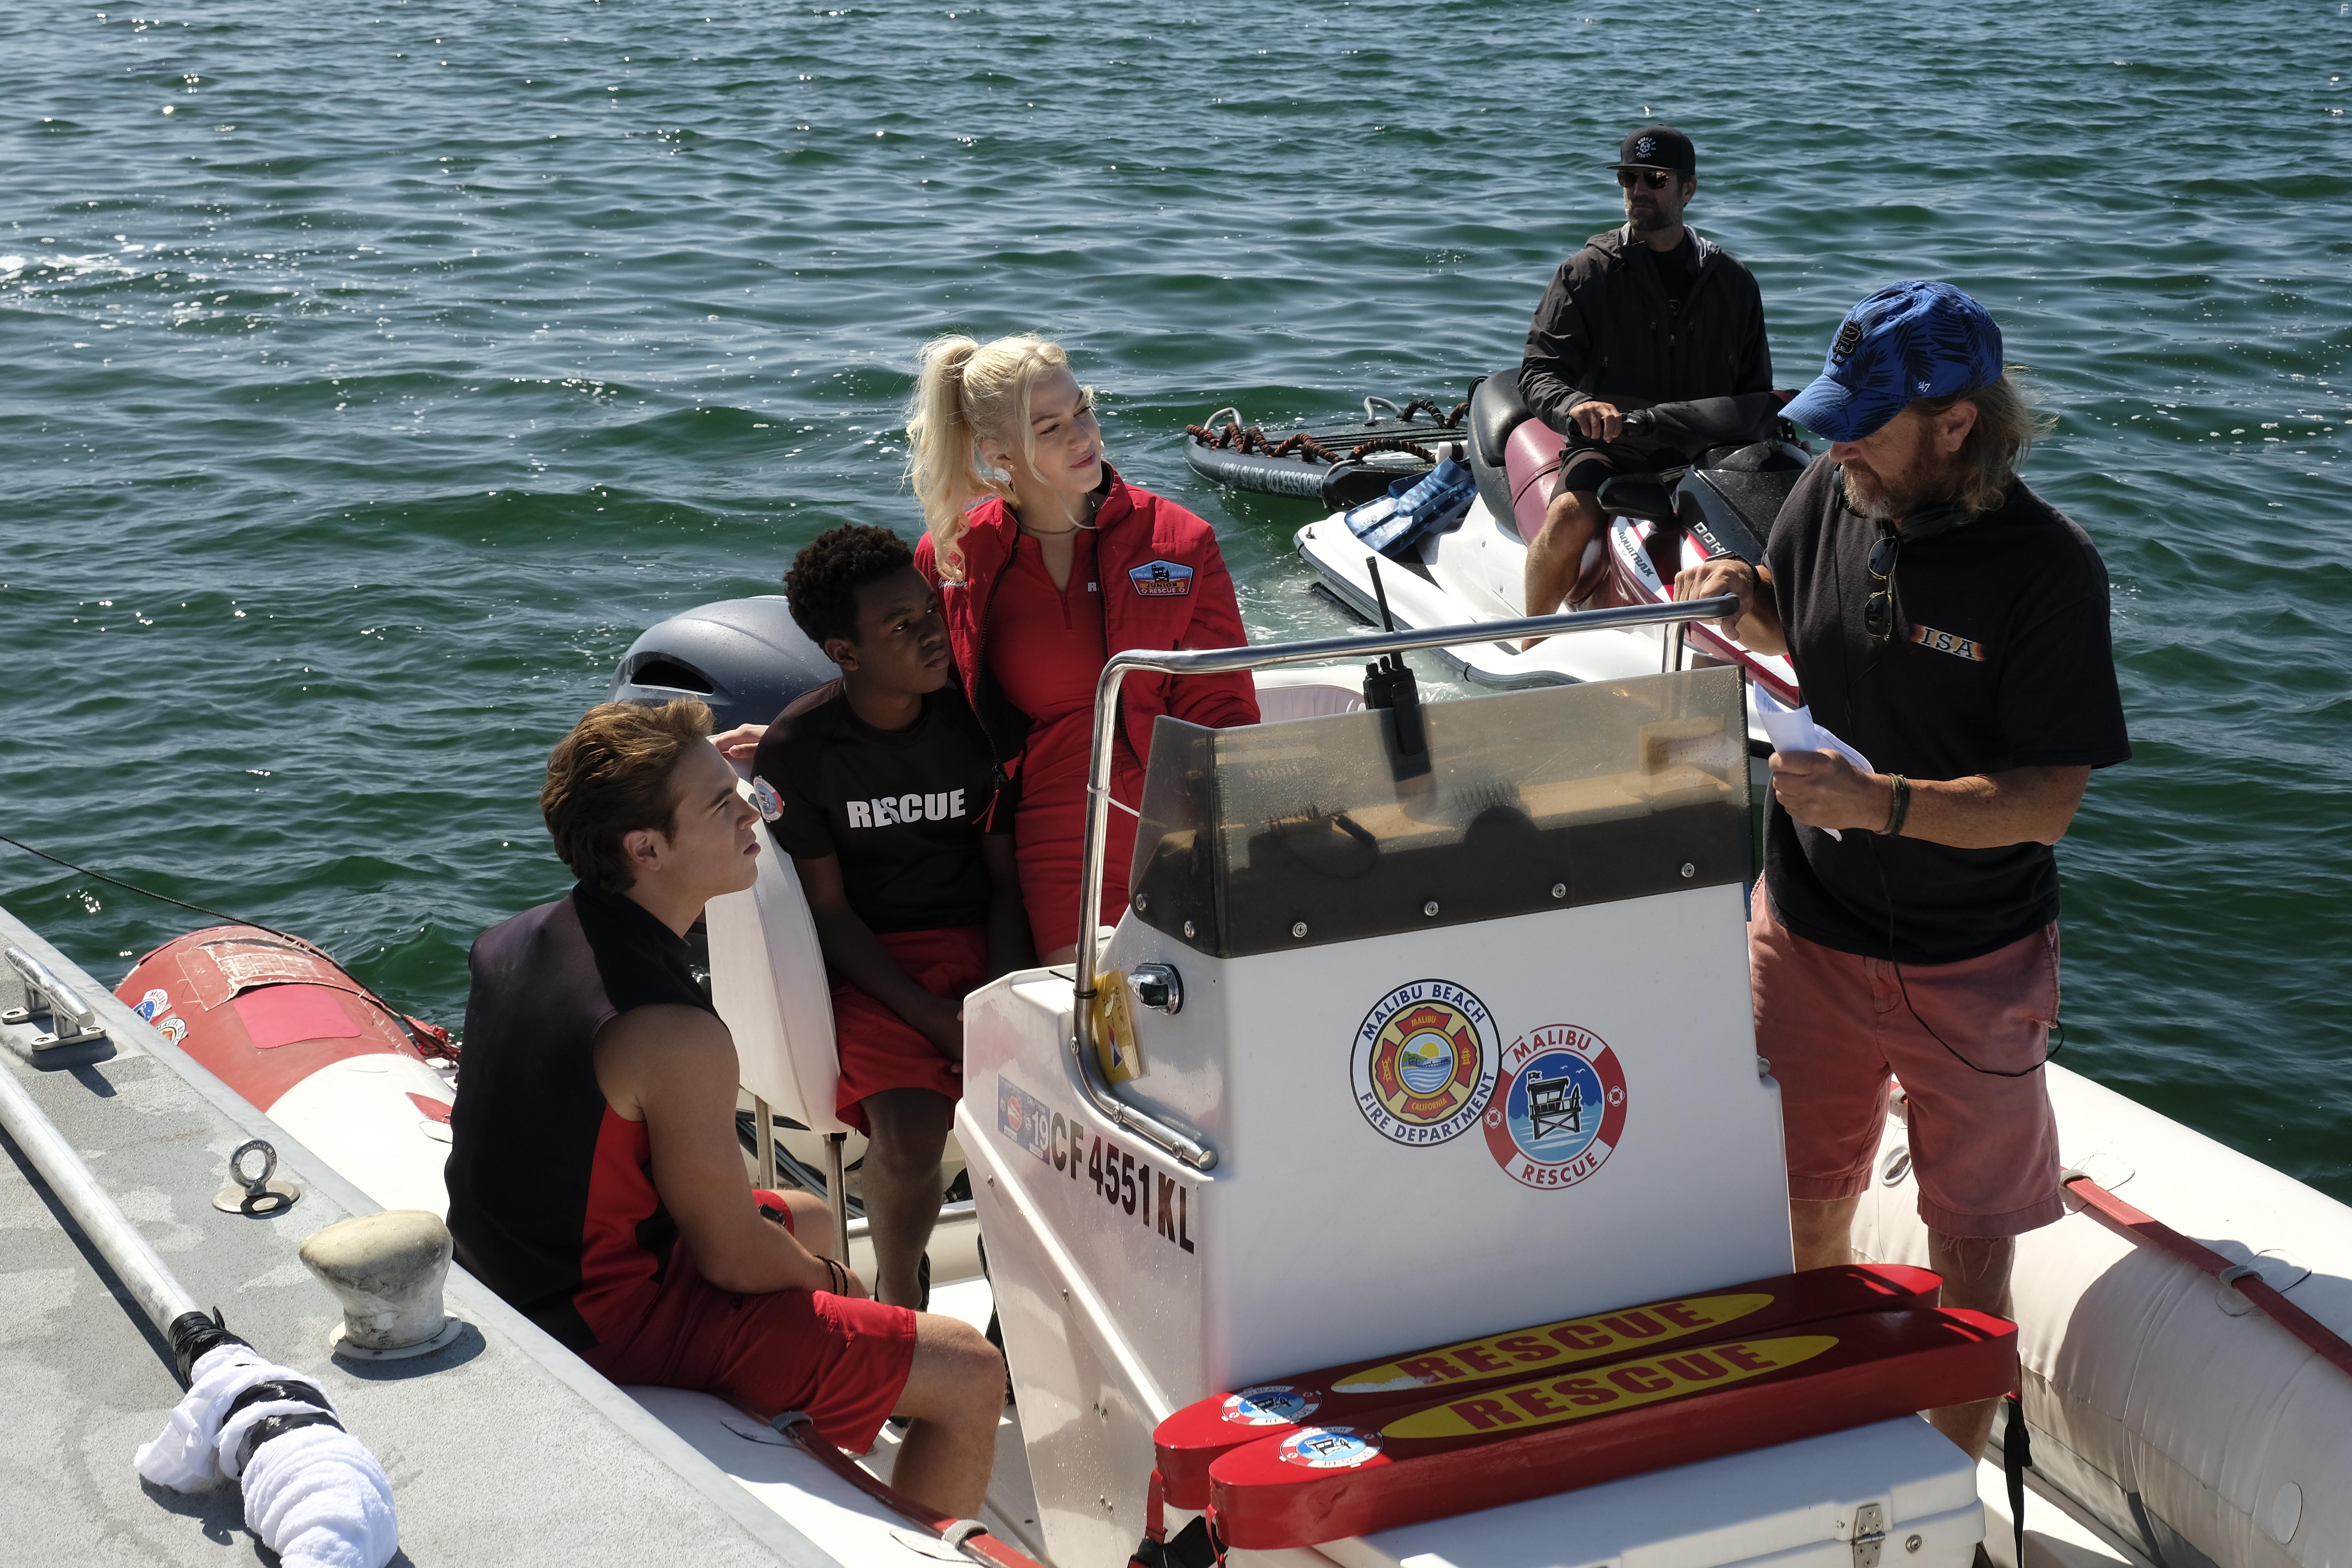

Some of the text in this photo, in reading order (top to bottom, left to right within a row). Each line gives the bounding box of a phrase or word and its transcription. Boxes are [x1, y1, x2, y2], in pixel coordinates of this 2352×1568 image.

[1266, 469, 1325, 498] ACCESSORIE
[1694, 522, 1726, 554] DOH
[1922, 628, 1974, 659] ISA
[847, 788, 965, 828] RESCUE
[149, 991, 165, 1009] MALIBU
[1362, 984, 1485, 1041] MALIBU BEACH
[1411, 1016, 1436, 1027] MALIBU
[1513, 1029, 1591, 1063] MALIBU
[1360, 1072, 1494, 1142] FIRE DEPARTMENT
[1411, 1098, 1447, 1111] CALIFORNIA
[1032, 1111, 1049, 1151] 19
[1051, 1112, 1194, 1255] CF 4551 KL
[1522, 1152, 1598, 1185] RESCUE
[1395, 1303, 1716, 1385] RESCUE
[1448, 1344, 1778, 1431] RESCUE
[1324, 1450, 1373, 1466] RESCUE
